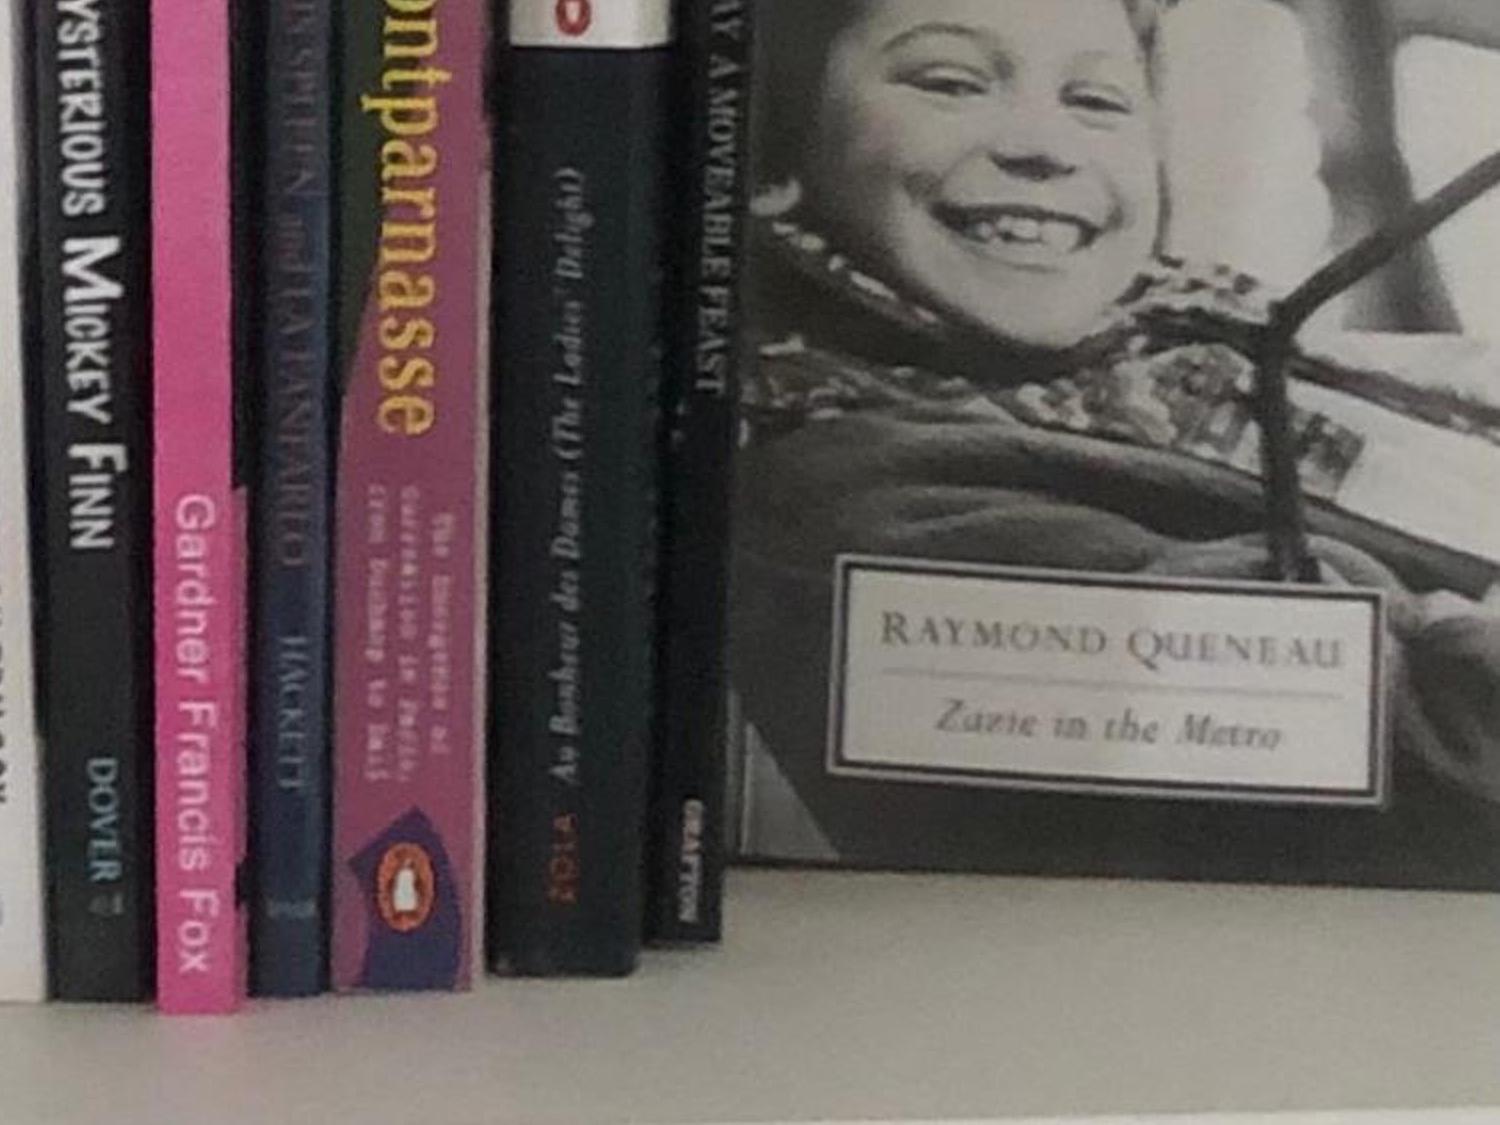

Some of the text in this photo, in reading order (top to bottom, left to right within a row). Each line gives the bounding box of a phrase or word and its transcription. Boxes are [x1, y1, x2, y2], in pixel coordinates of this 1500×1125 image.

[708, 53, 740, 78] A
[701, 89, 739, 275] MOVEABLE
[695, 286, 732, 395] FEAST
[880, 610, 1344, 671] RAYMOND QUENEAU
[175, 493, 221, 973] Gardner Francis Fox
[935, 697, 1283, 752] Zazie in the Metro
[86, 756, 123, 884] DOVER
